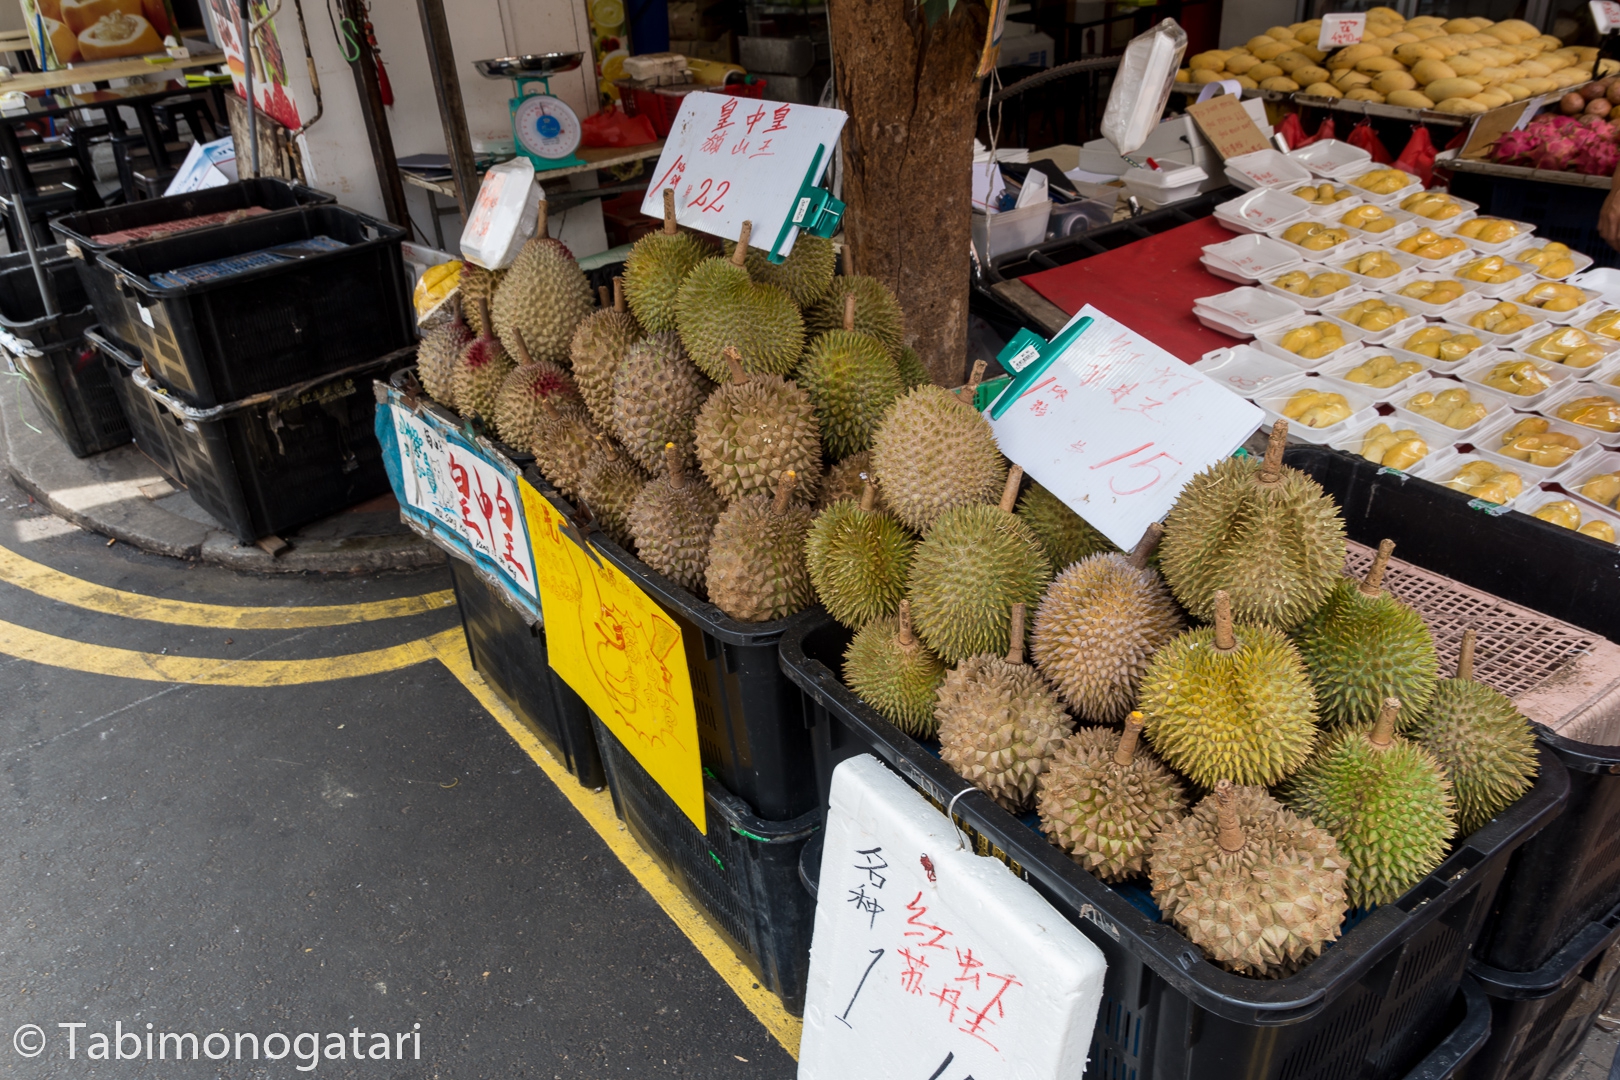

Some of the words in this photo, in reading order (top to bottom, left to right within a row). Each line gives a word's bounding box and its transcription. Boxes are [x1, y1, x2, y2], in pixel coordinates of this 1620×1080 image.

[711, 97, 791, 134] 皇中皇
[687, 177, 731, 213] 22
[1089, 441, 1183, 496] 15
[448, 451, 529, 582] 皇中皇
